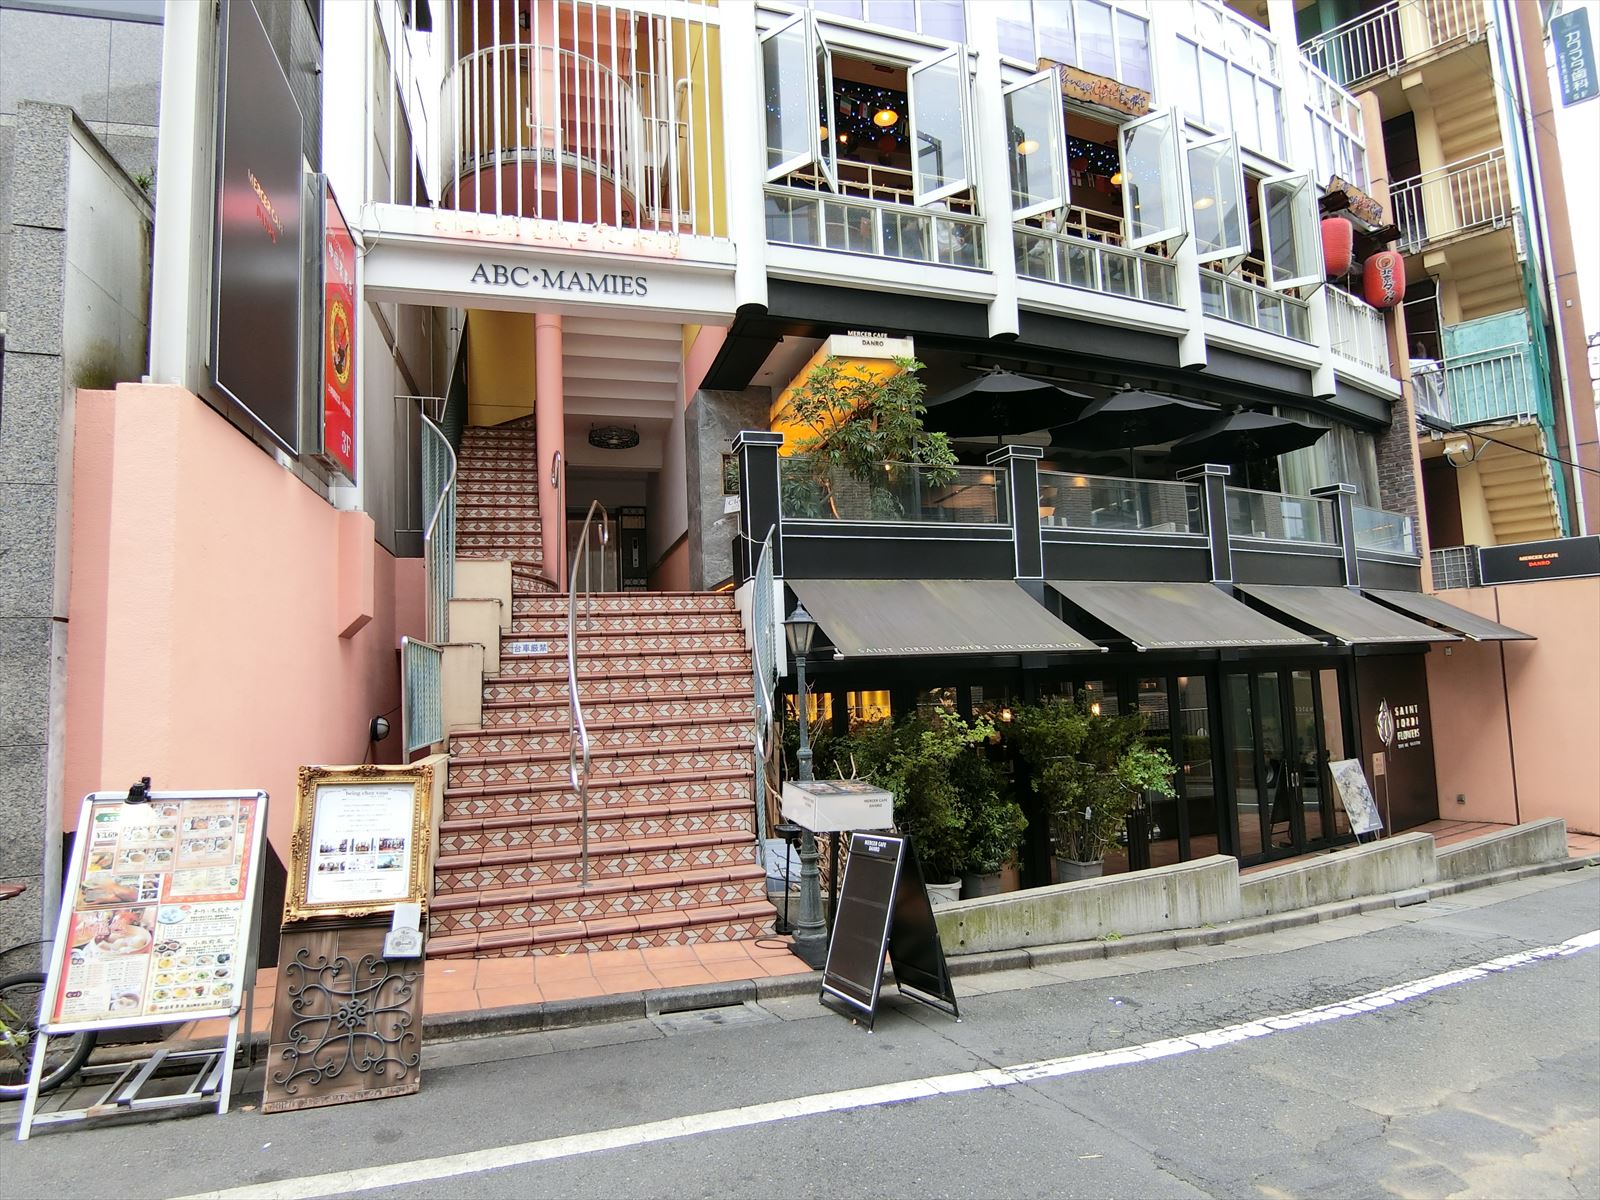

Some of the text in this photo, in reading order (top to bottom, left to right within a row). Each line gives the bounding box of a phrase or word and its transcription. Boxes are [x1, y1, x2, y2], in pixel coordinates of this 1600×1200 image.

[847, 330, 872, 338] MERCER
[341, 431, 352, 457] 3F
[1394, 704, 1418, 717] SAINT
[1397, 728, 1420, 741] FLOWERS
